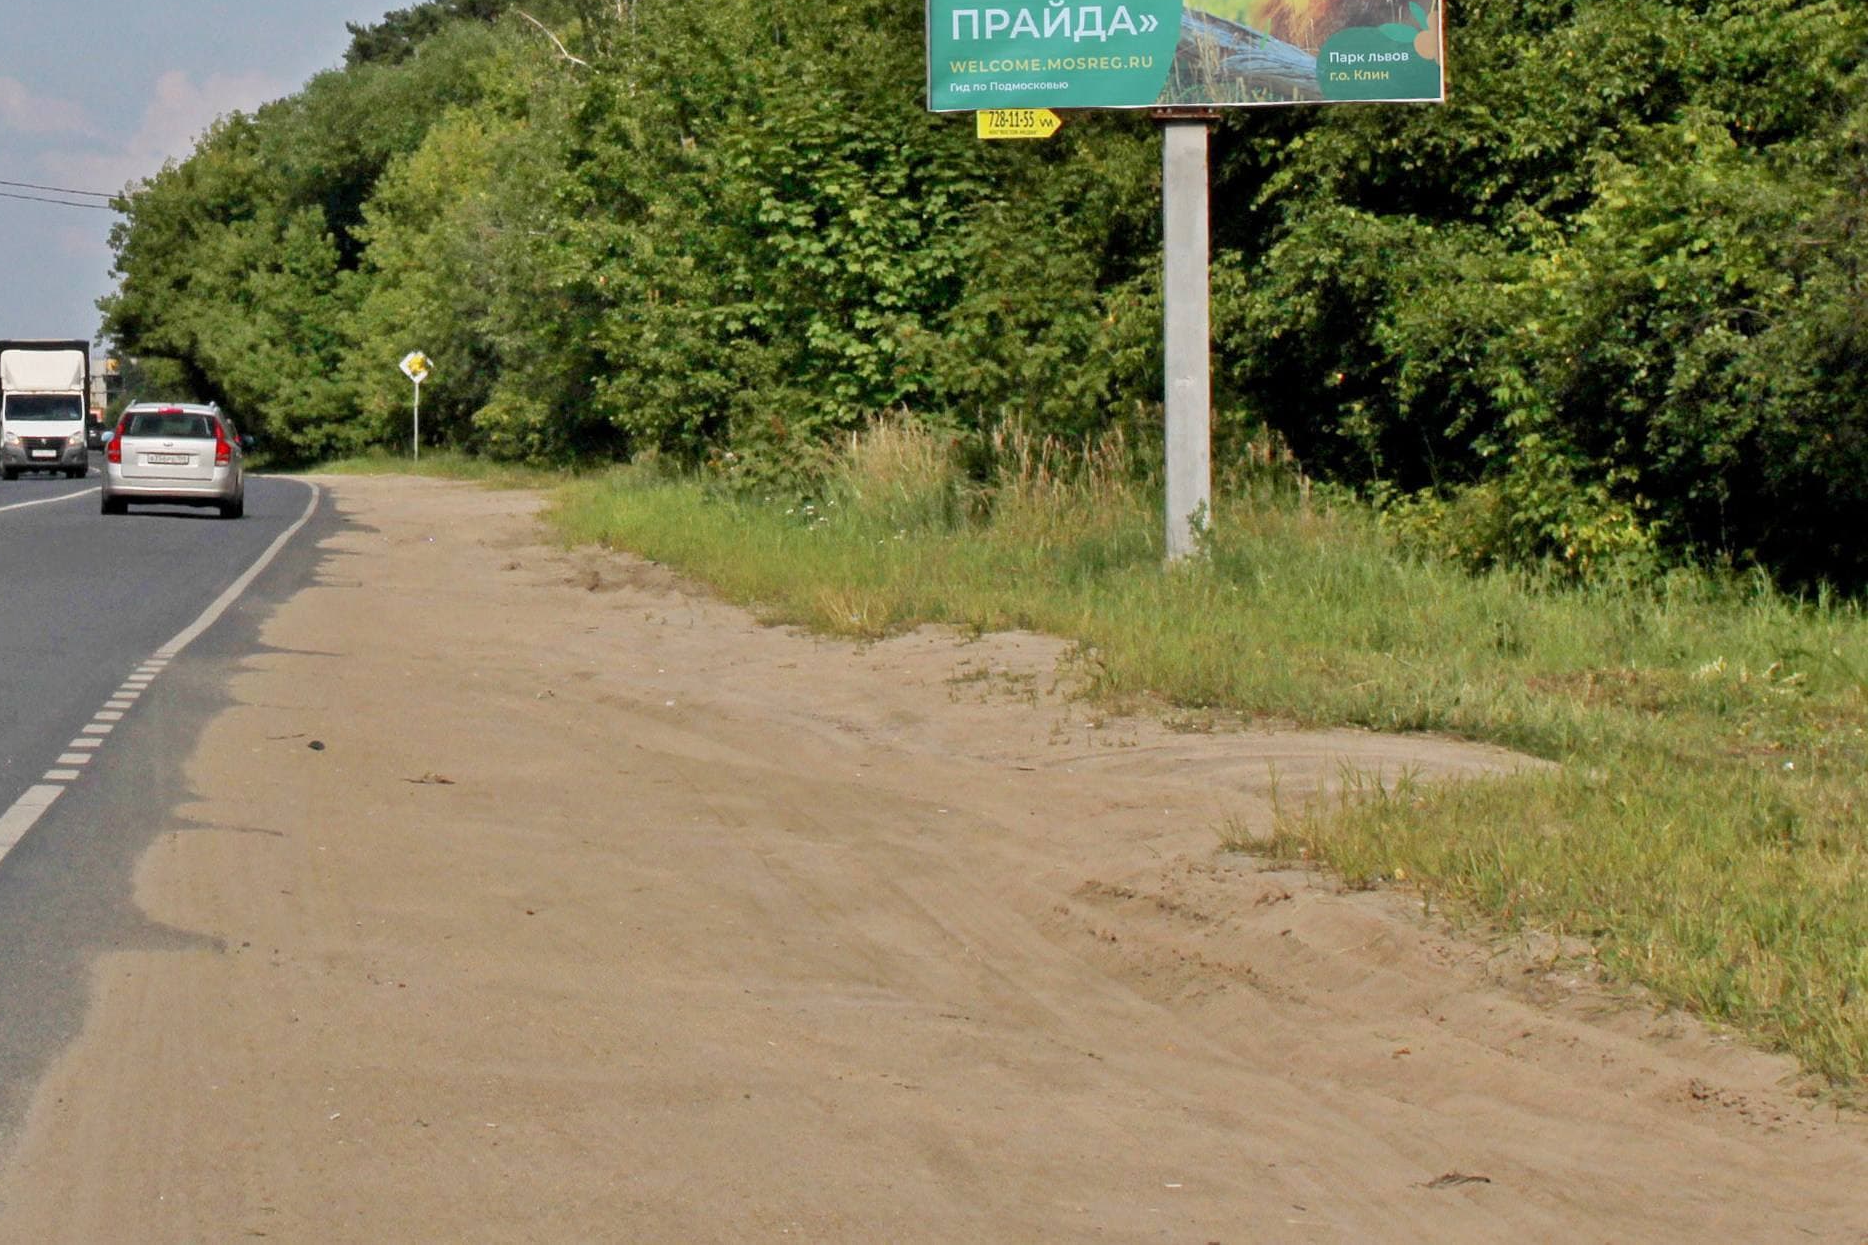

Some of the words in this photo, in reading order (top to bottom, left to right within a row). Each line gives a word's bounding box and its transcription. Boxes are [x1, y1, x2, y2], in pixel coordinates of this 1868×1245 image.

[951, 0, 1159, 43] ПРАЙДА»
[949, 55, 1154, 74] WELCOME.MOSREG.RU
[1329, 51, 1365, 65] Парк
[1368, 52, 1409, 63] львов
[1329, 72, 1351, 82] г.о.
[1354, 70, 1390, 81] Клин
[950, 82, 971, 93] Гид
[973, 83, 988, 92] по
[990, 81, 1069, 92] Подмосковью
[989, 110, 1035, 128] 728-11-55
